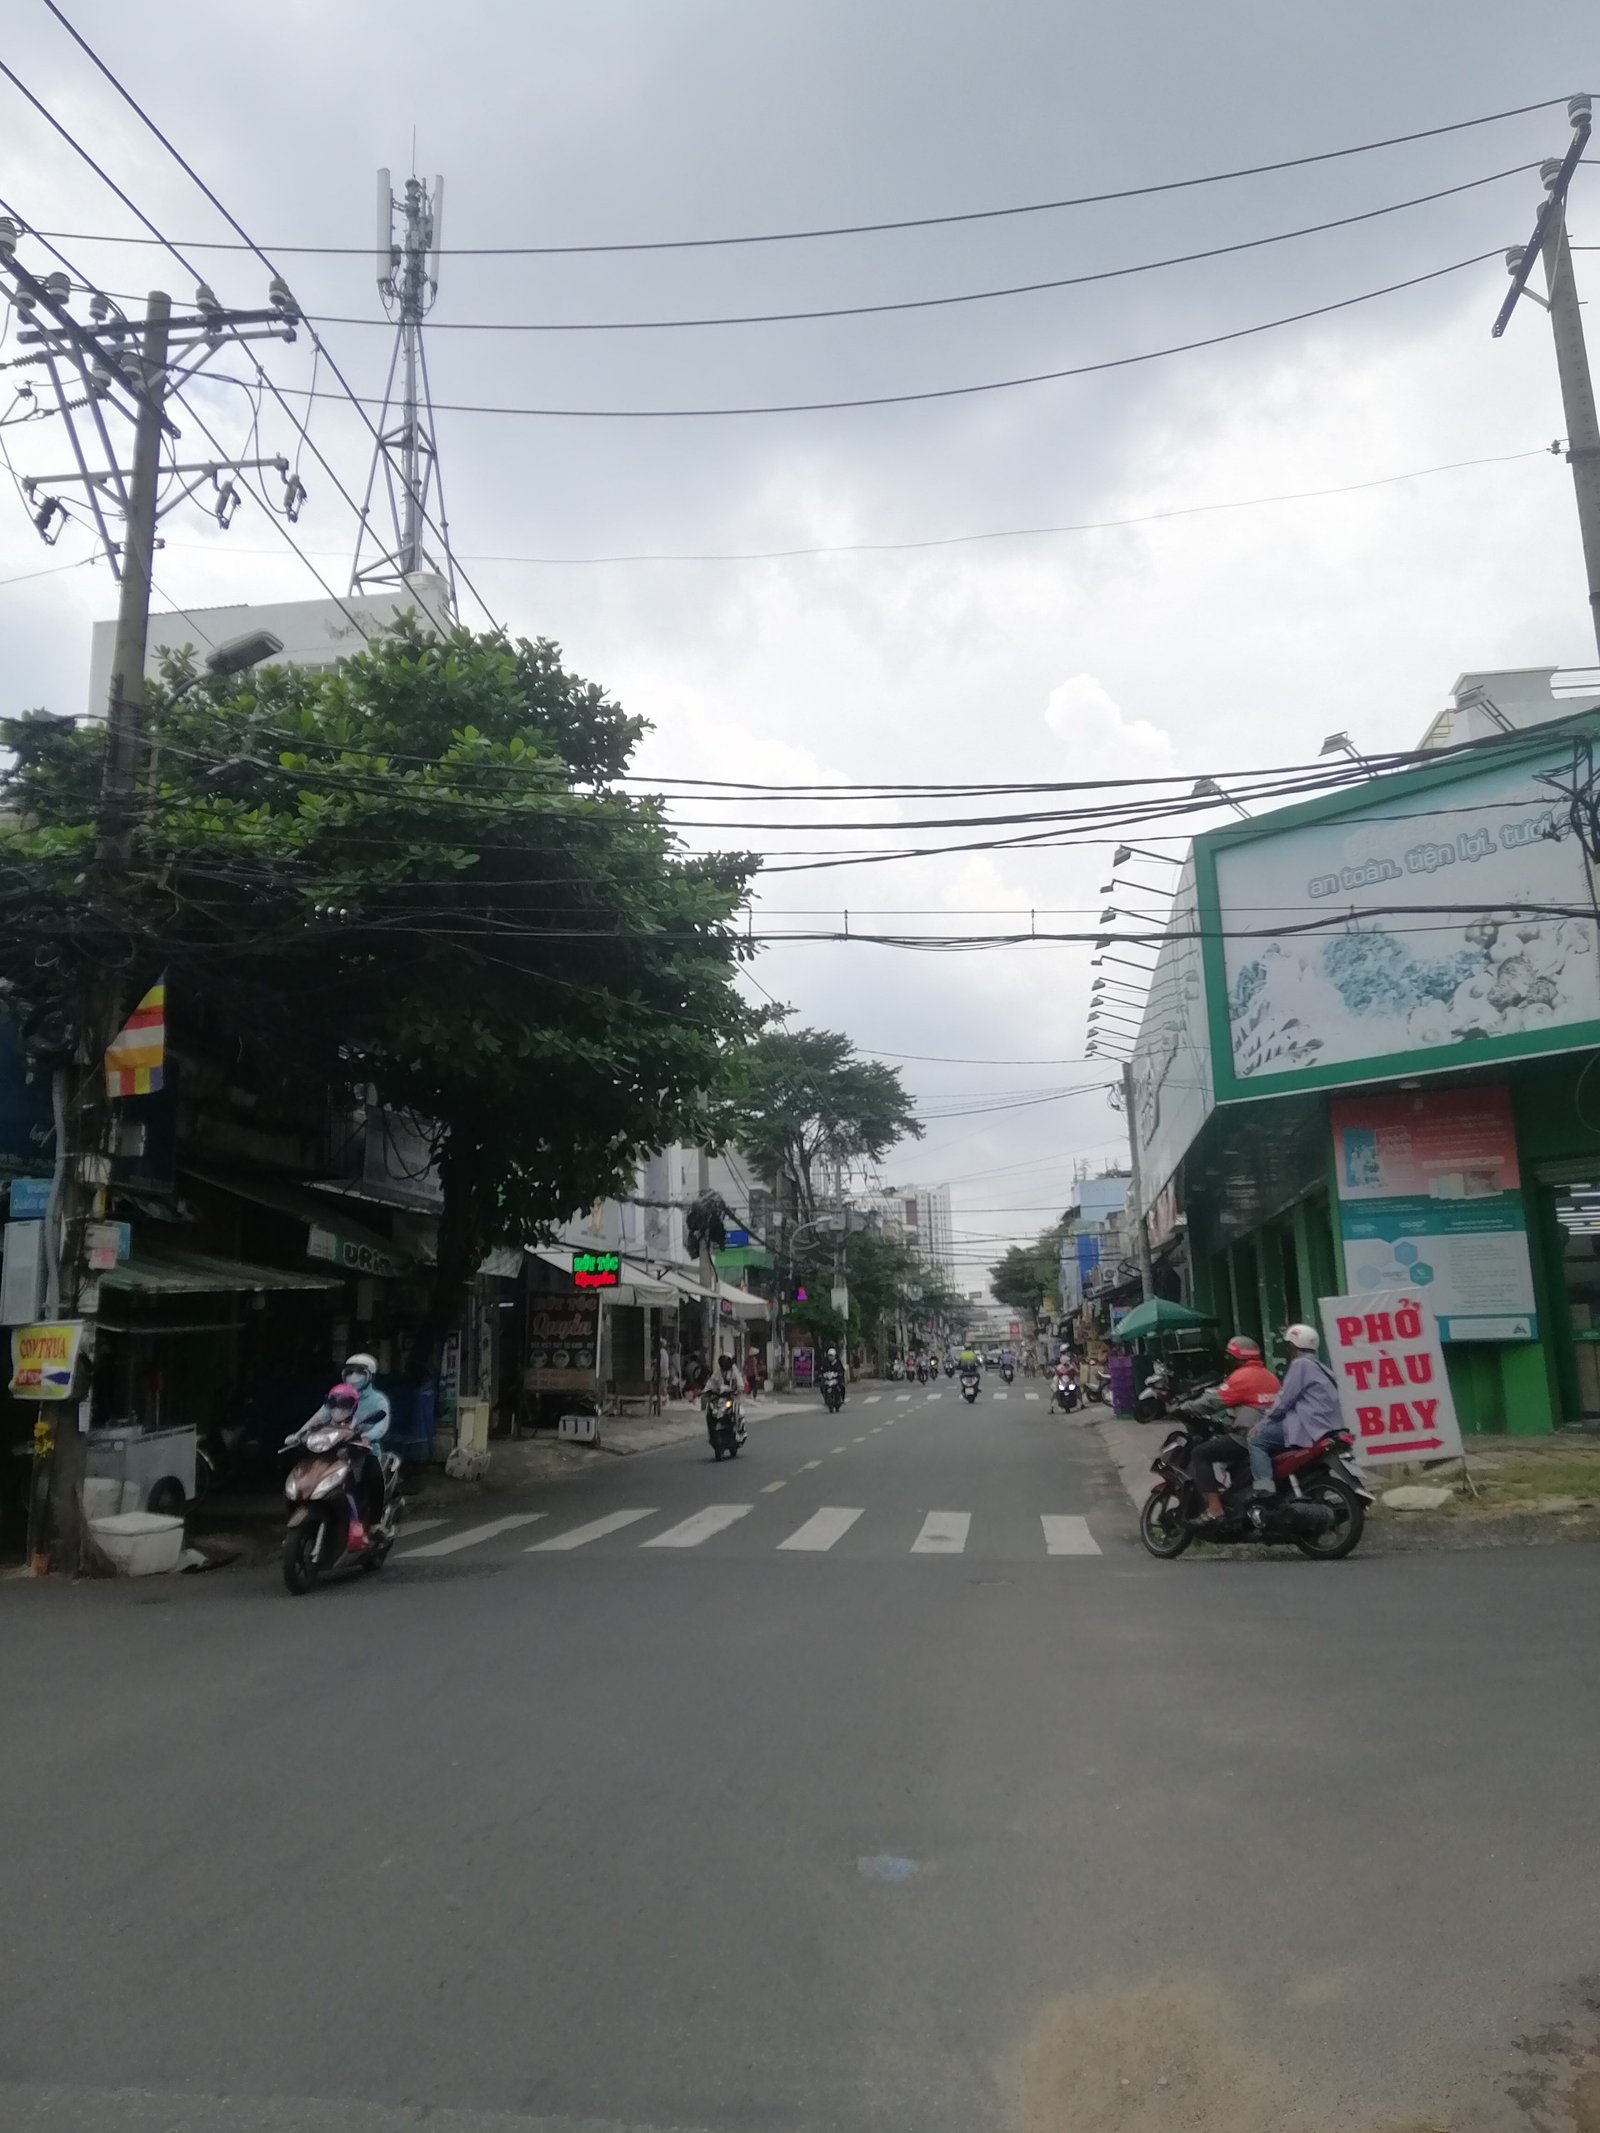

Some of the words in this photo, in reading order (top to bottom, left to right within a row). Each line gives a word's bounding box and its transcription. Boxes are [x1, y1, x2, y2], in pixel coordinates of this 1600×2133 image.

[1309, 875, 1338, 897] an
[1336, 1298, 1422, 1346] PHỞ
[1344, 1350, 1433, 1391] TÀU
[1355, 1399, 1438, 1436] BAY
